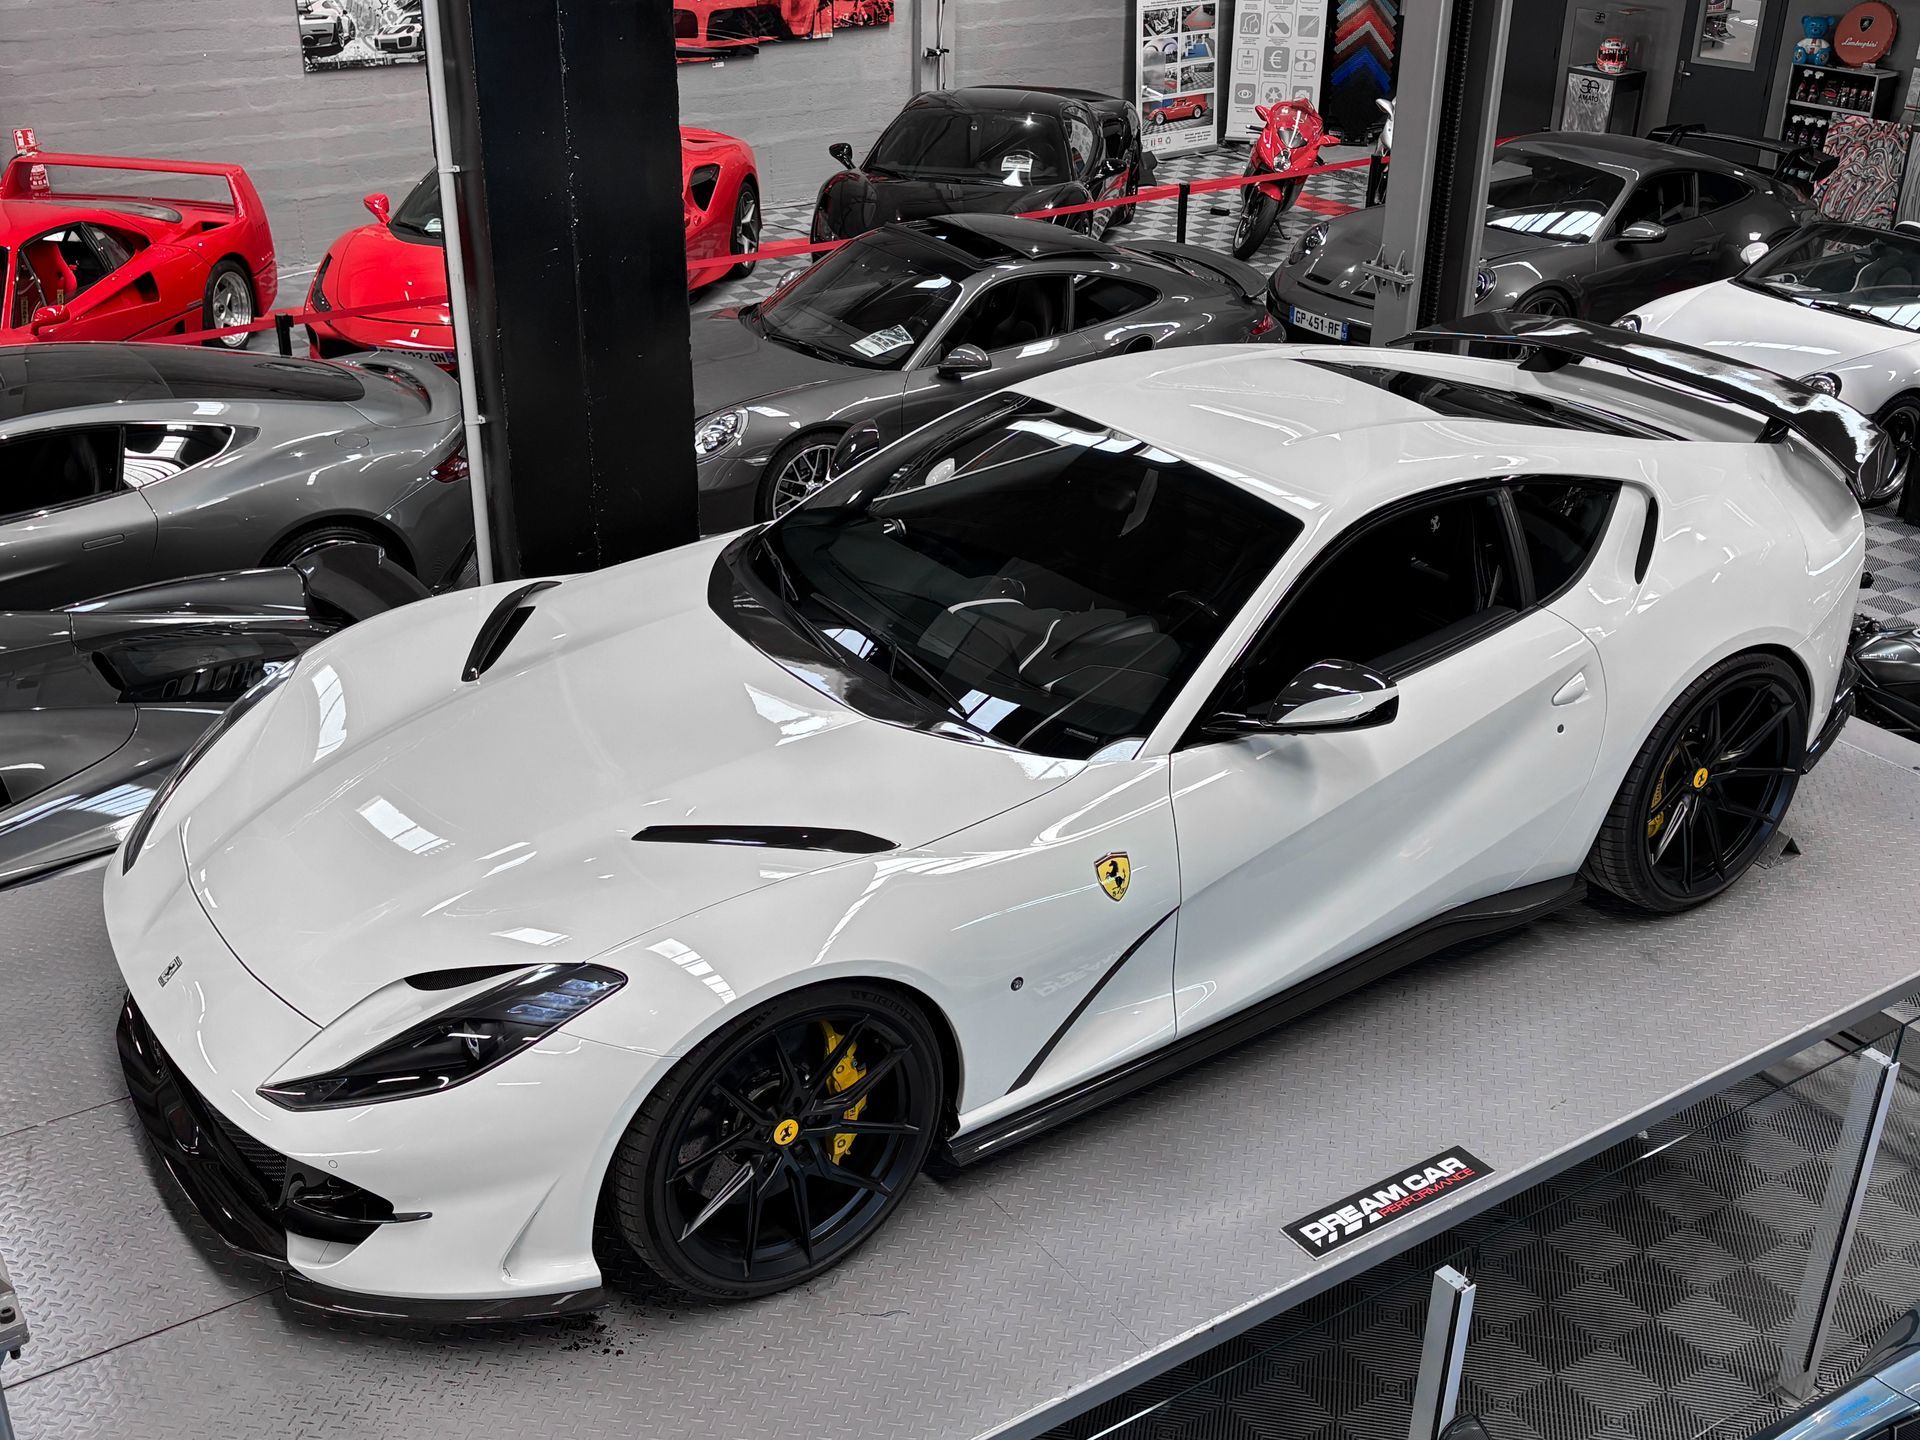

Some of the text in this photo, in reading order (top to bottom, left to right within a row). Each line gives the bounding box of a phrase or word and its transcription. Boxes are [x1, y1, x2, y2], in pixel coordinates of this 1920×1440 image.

[1841, 37, 1878, 48] Lamborghini
[1299, 1157, 1467, 1243] DREAM CAR
[1378, 1167, 1475, 1217] PERFORMANCE
